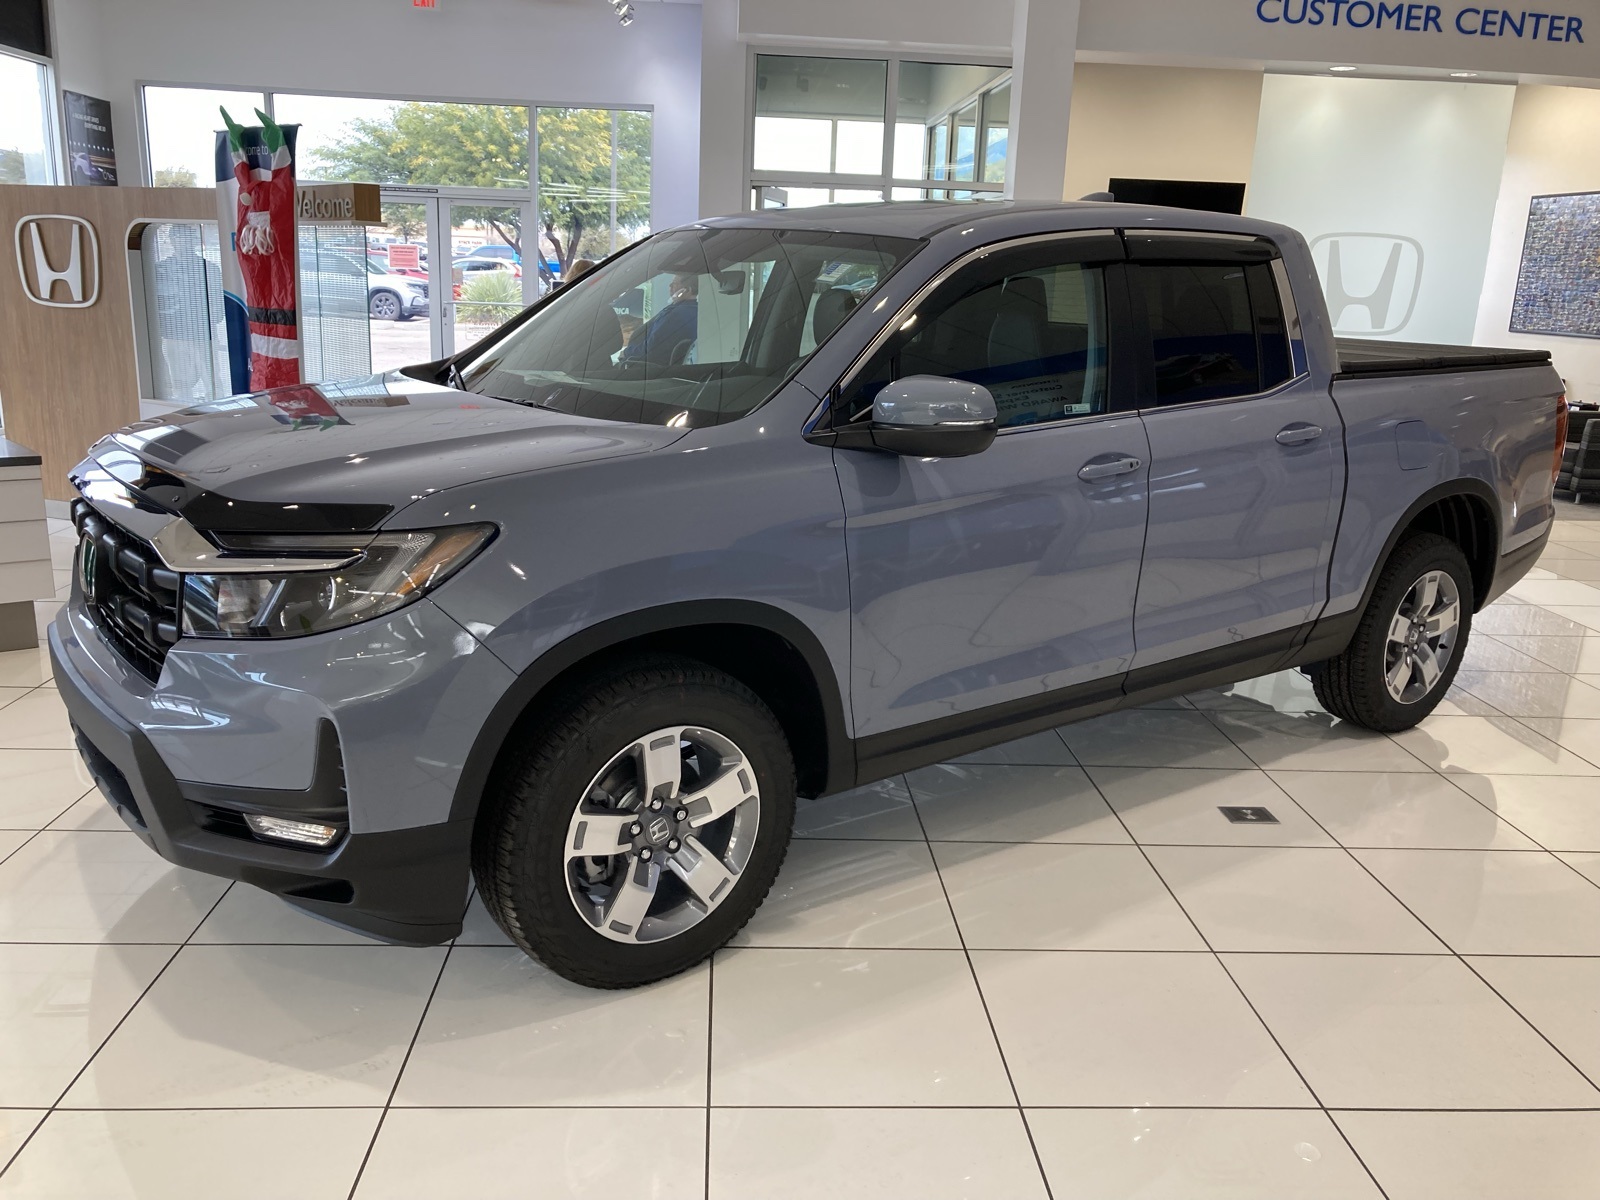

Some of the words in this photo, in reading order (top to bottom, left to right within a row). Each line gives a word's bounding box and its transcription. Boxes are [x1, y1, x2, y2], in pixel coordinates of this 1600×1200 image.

[1256, 0, 1443, 33] CUSTOMER
[1455, 7, 1584, 43] CENTER
[261, 144, 269, 156] to
